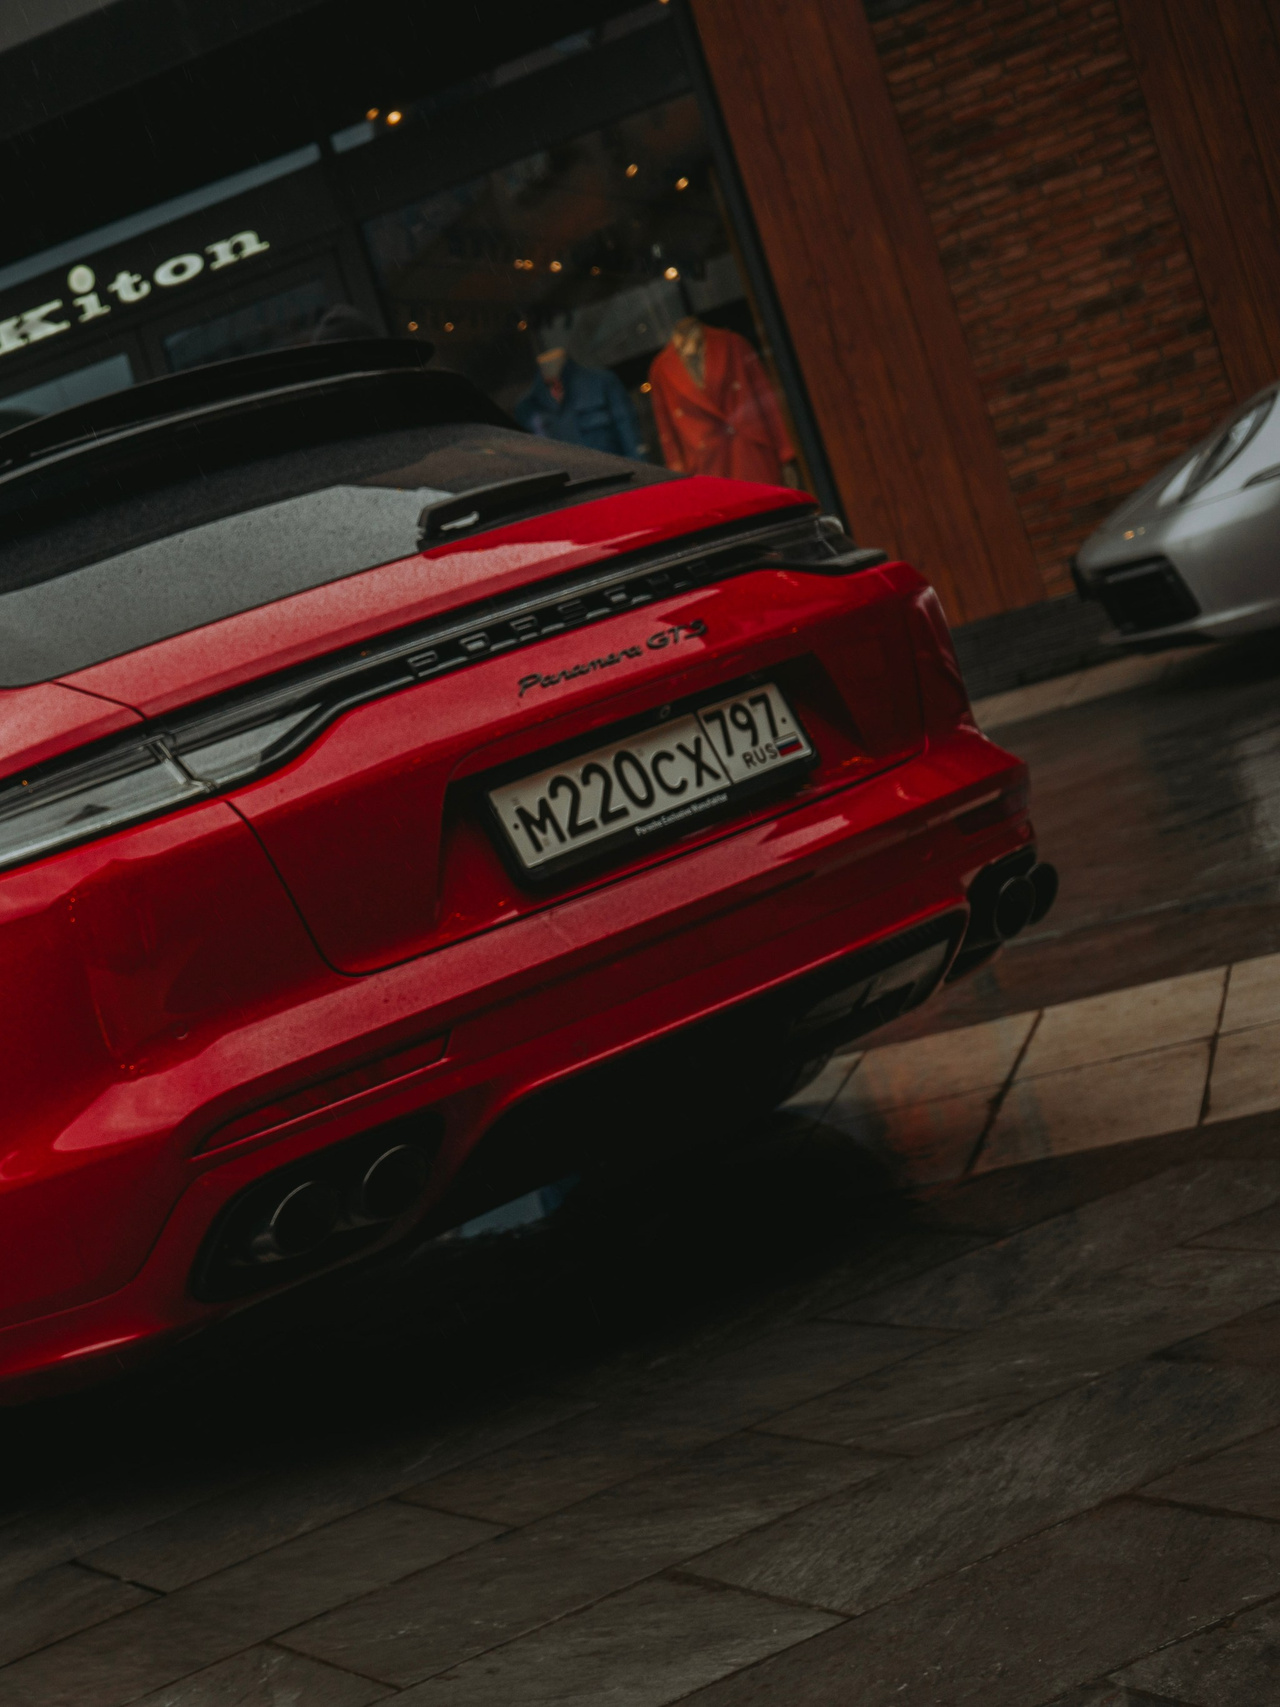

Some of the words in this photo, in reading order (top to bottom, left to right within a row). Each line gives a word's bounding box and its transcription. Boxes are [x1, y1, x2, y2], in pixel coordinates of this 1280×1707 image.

[406, 560, 714, 678] PORSCHE
[518, 645, 643, 697] Panamera
[646, 619, 707, 649] GTS
[703, 692, 778, 757] 797
[742, 743, 778, 769] RUS
